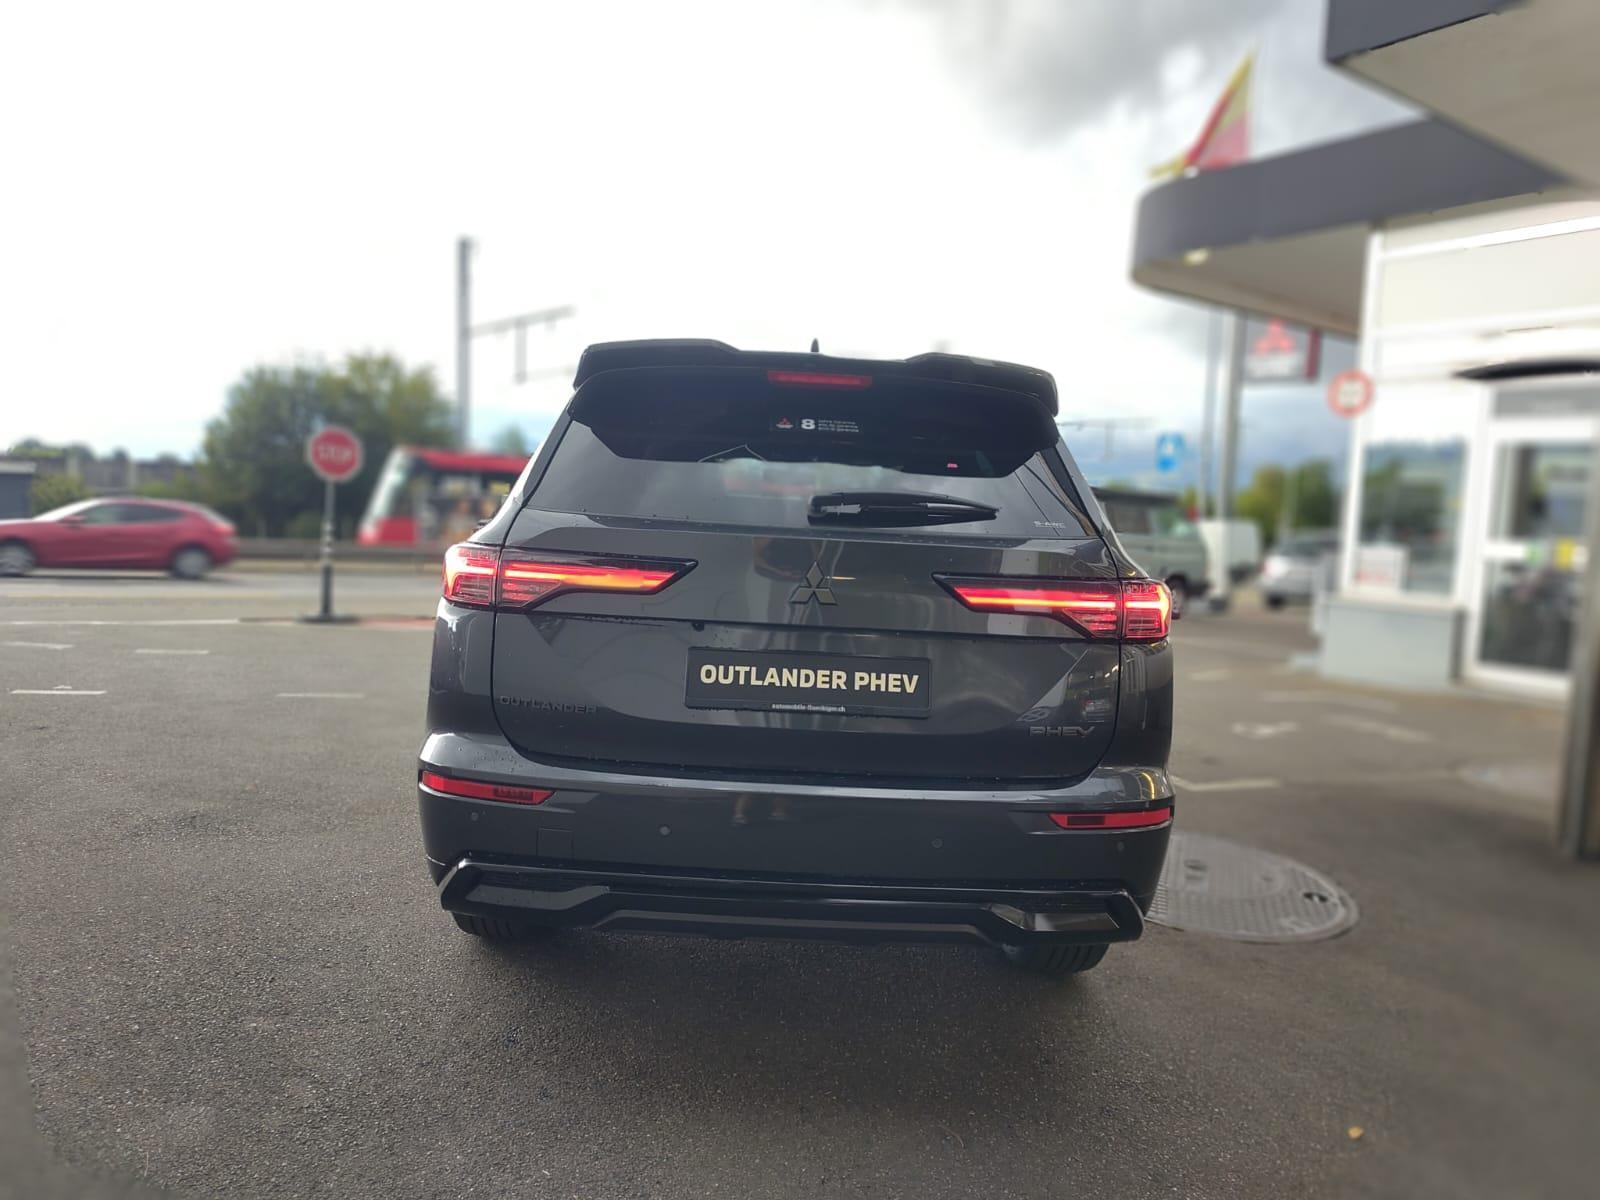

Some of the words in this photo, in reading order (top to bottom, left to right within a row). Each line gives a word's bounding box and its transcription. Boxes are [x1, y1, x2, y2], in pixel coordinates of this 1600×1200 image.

[801, 418, 816, 430] 8
[699, 664, 848, 691] OUTLANDER
[854, 671, 919, 694] PHEV
[500, 695, 598, 713] OUTLANDER
[1029, 726, 1096, 738] PHEV
